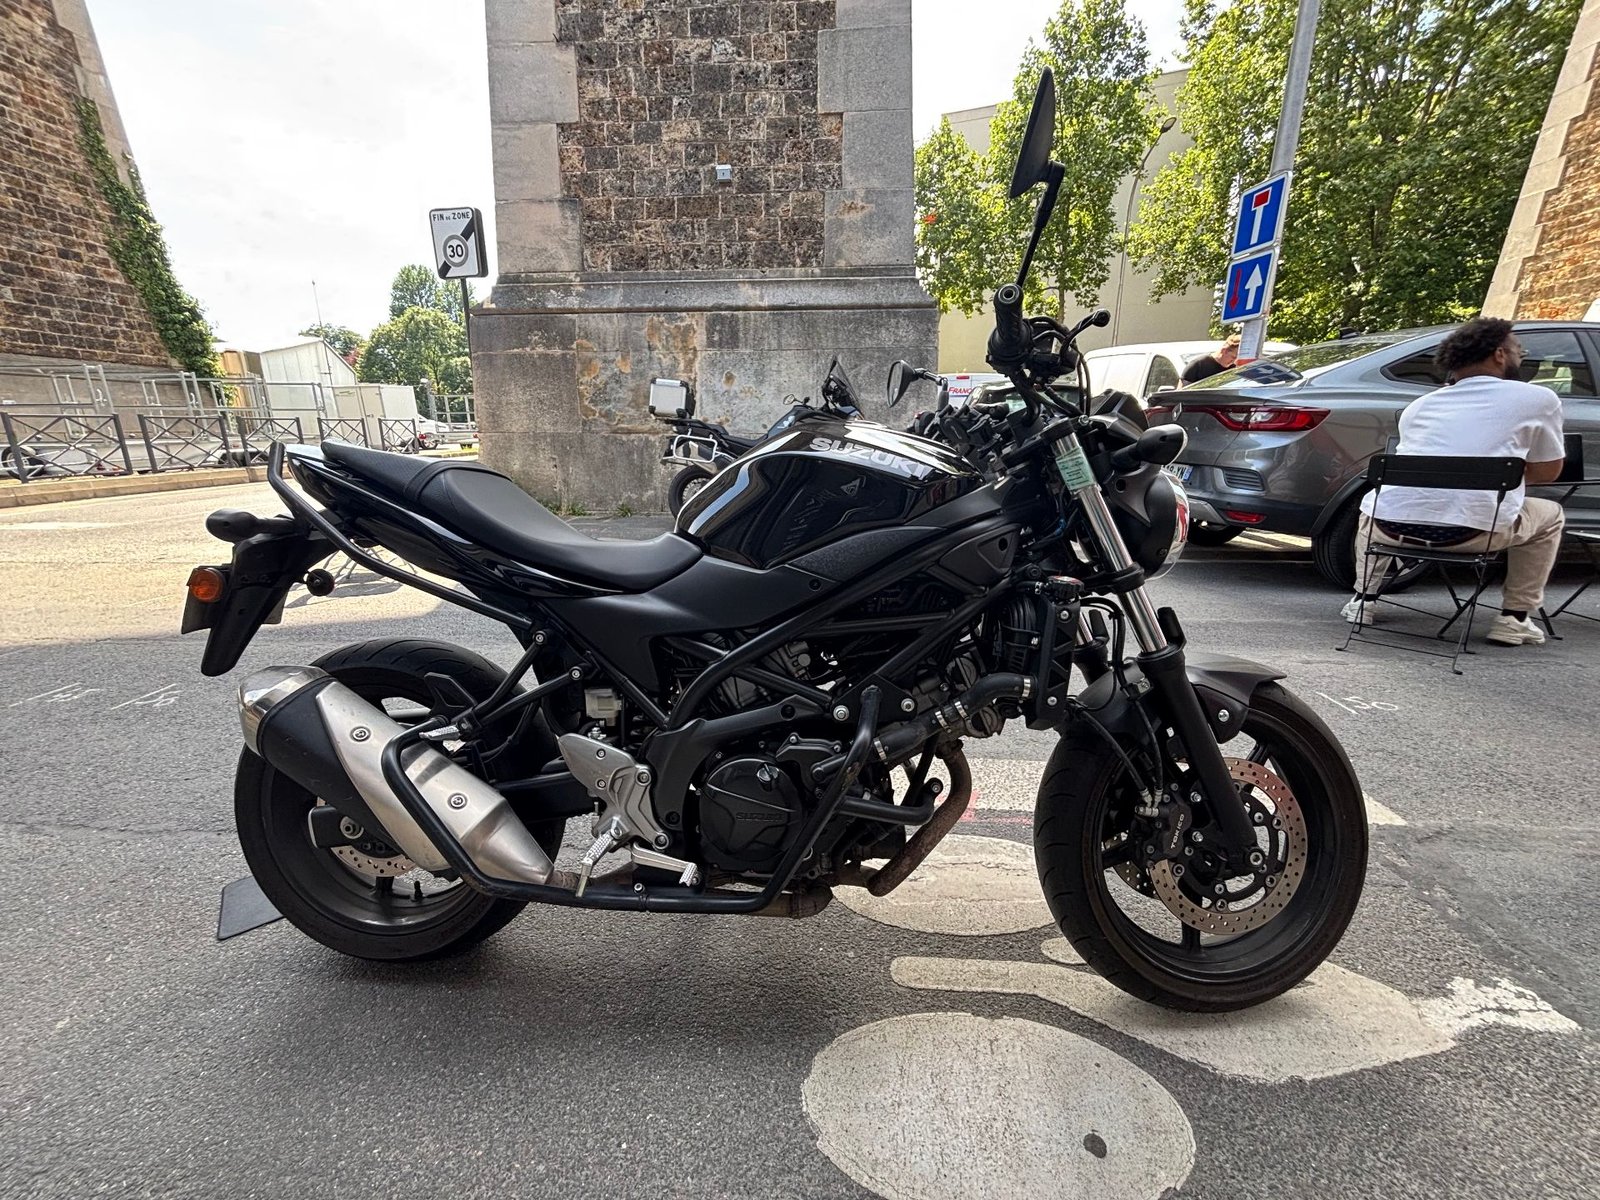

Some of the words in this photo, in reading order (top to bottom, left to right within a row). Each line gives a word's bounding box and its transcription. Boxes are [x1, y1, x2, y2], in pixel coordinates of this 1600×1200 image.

[432, 213, 444, 221] FIN
[452, 211, 470, 220] ZONE
[448, 244, 464, 258] 30
[809, 437, 933, 480] SUZUKI
